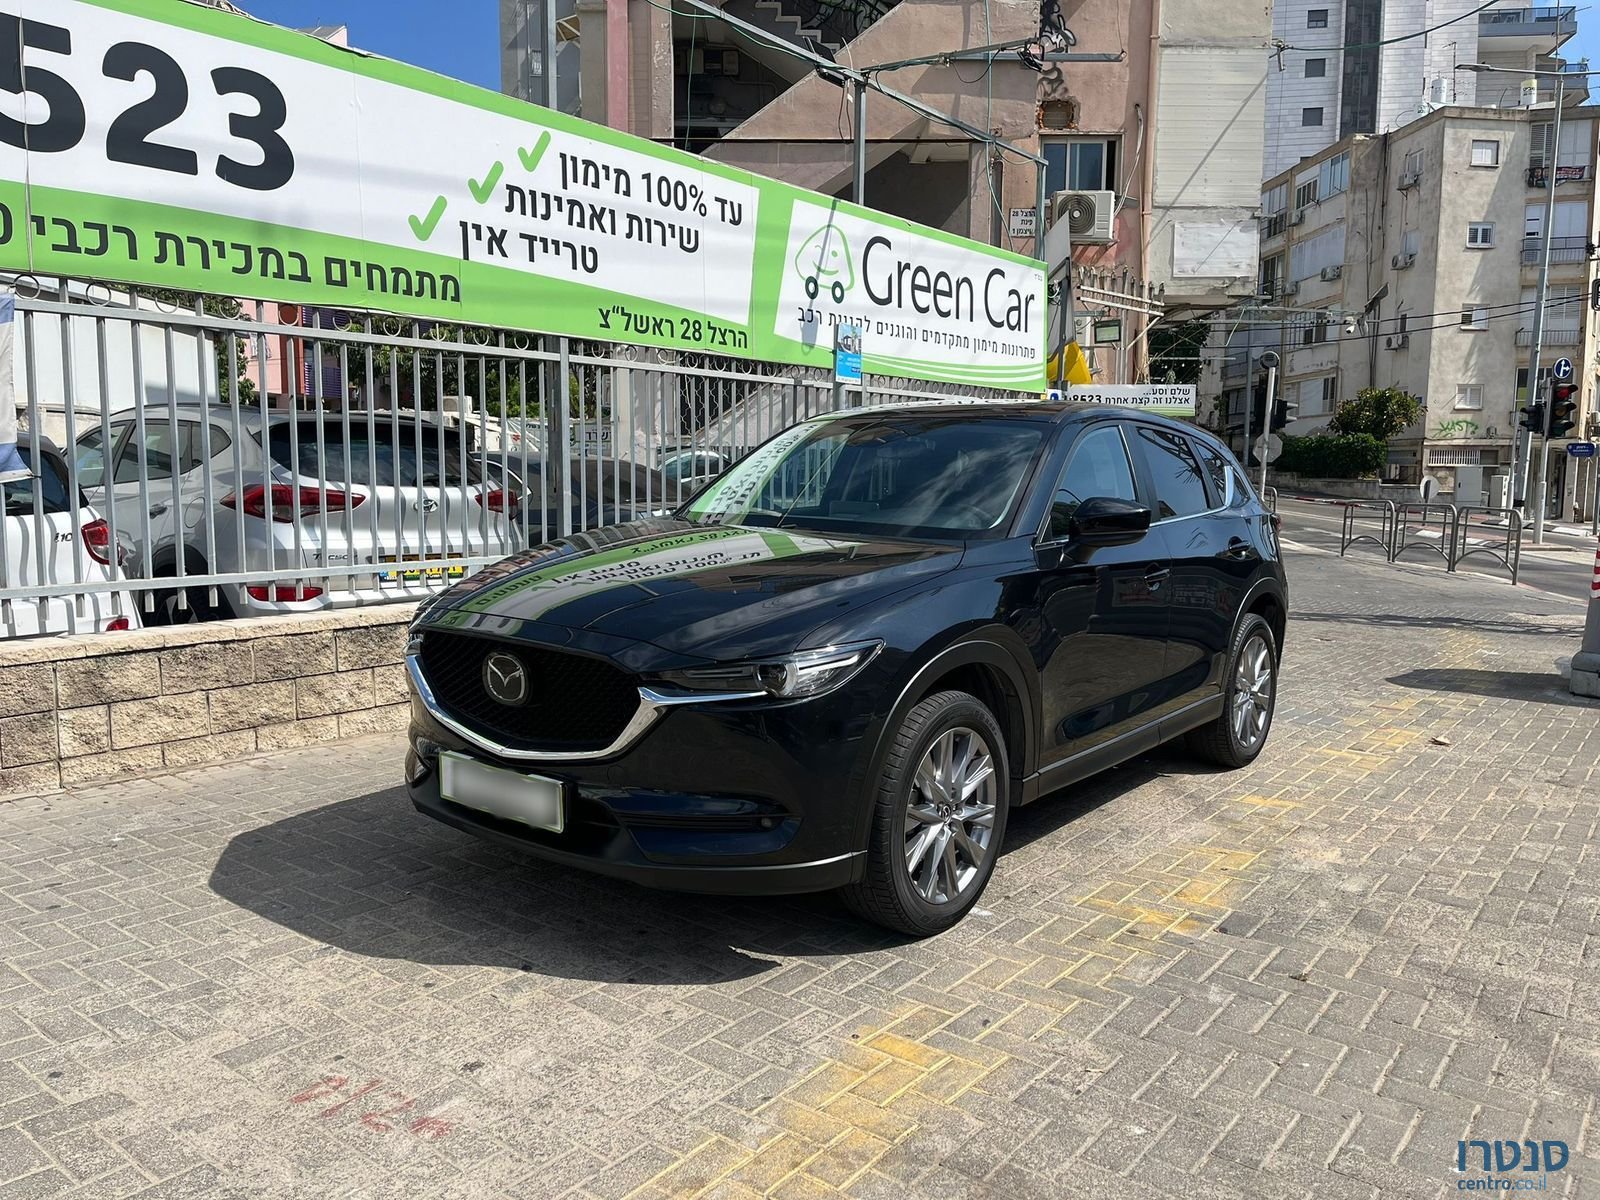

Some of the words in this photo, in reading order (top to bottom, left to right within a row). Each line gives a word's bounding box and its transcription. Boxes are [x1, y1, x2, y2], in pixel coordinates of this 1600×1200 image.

[0, 13, 295, 191] 523
[559, 152, 632, 198] מימון
[505, 183, 616, 236] ואמינות
[641, 172, 707, 217] 100%
[714, 196, 743, 226] עד
[30, 214, 138, 260] רכבי
[459, 220, 508, 261] אין
[625, 212, 699, 254] שירות
[154, 230, 312, 283] במכירת
[519, 232, 599, 274] טרייד
[324, 254, 461, 302] מתמחים
[862, 235, 974, 323] Green
[984, 267, 1035, 333] Car
[680, 317, 703, 342] 28
[797, 306, 822, 325] רכב
[707, 320, 748, 349] הרצל
[876, 321, 917, 341] והוגנים
[922, 329, 969, 349] מתקדמים
[973, 337, 998, 354] מימון
[1001, 342, 1036, 359] פתרונות
[1131, 397, 1150, 406] קצת
[1165, 396, 1190, 405] אצלנו
[1170, 387, 1191, 395] שלם
[54, 532, 73, 543] i10
